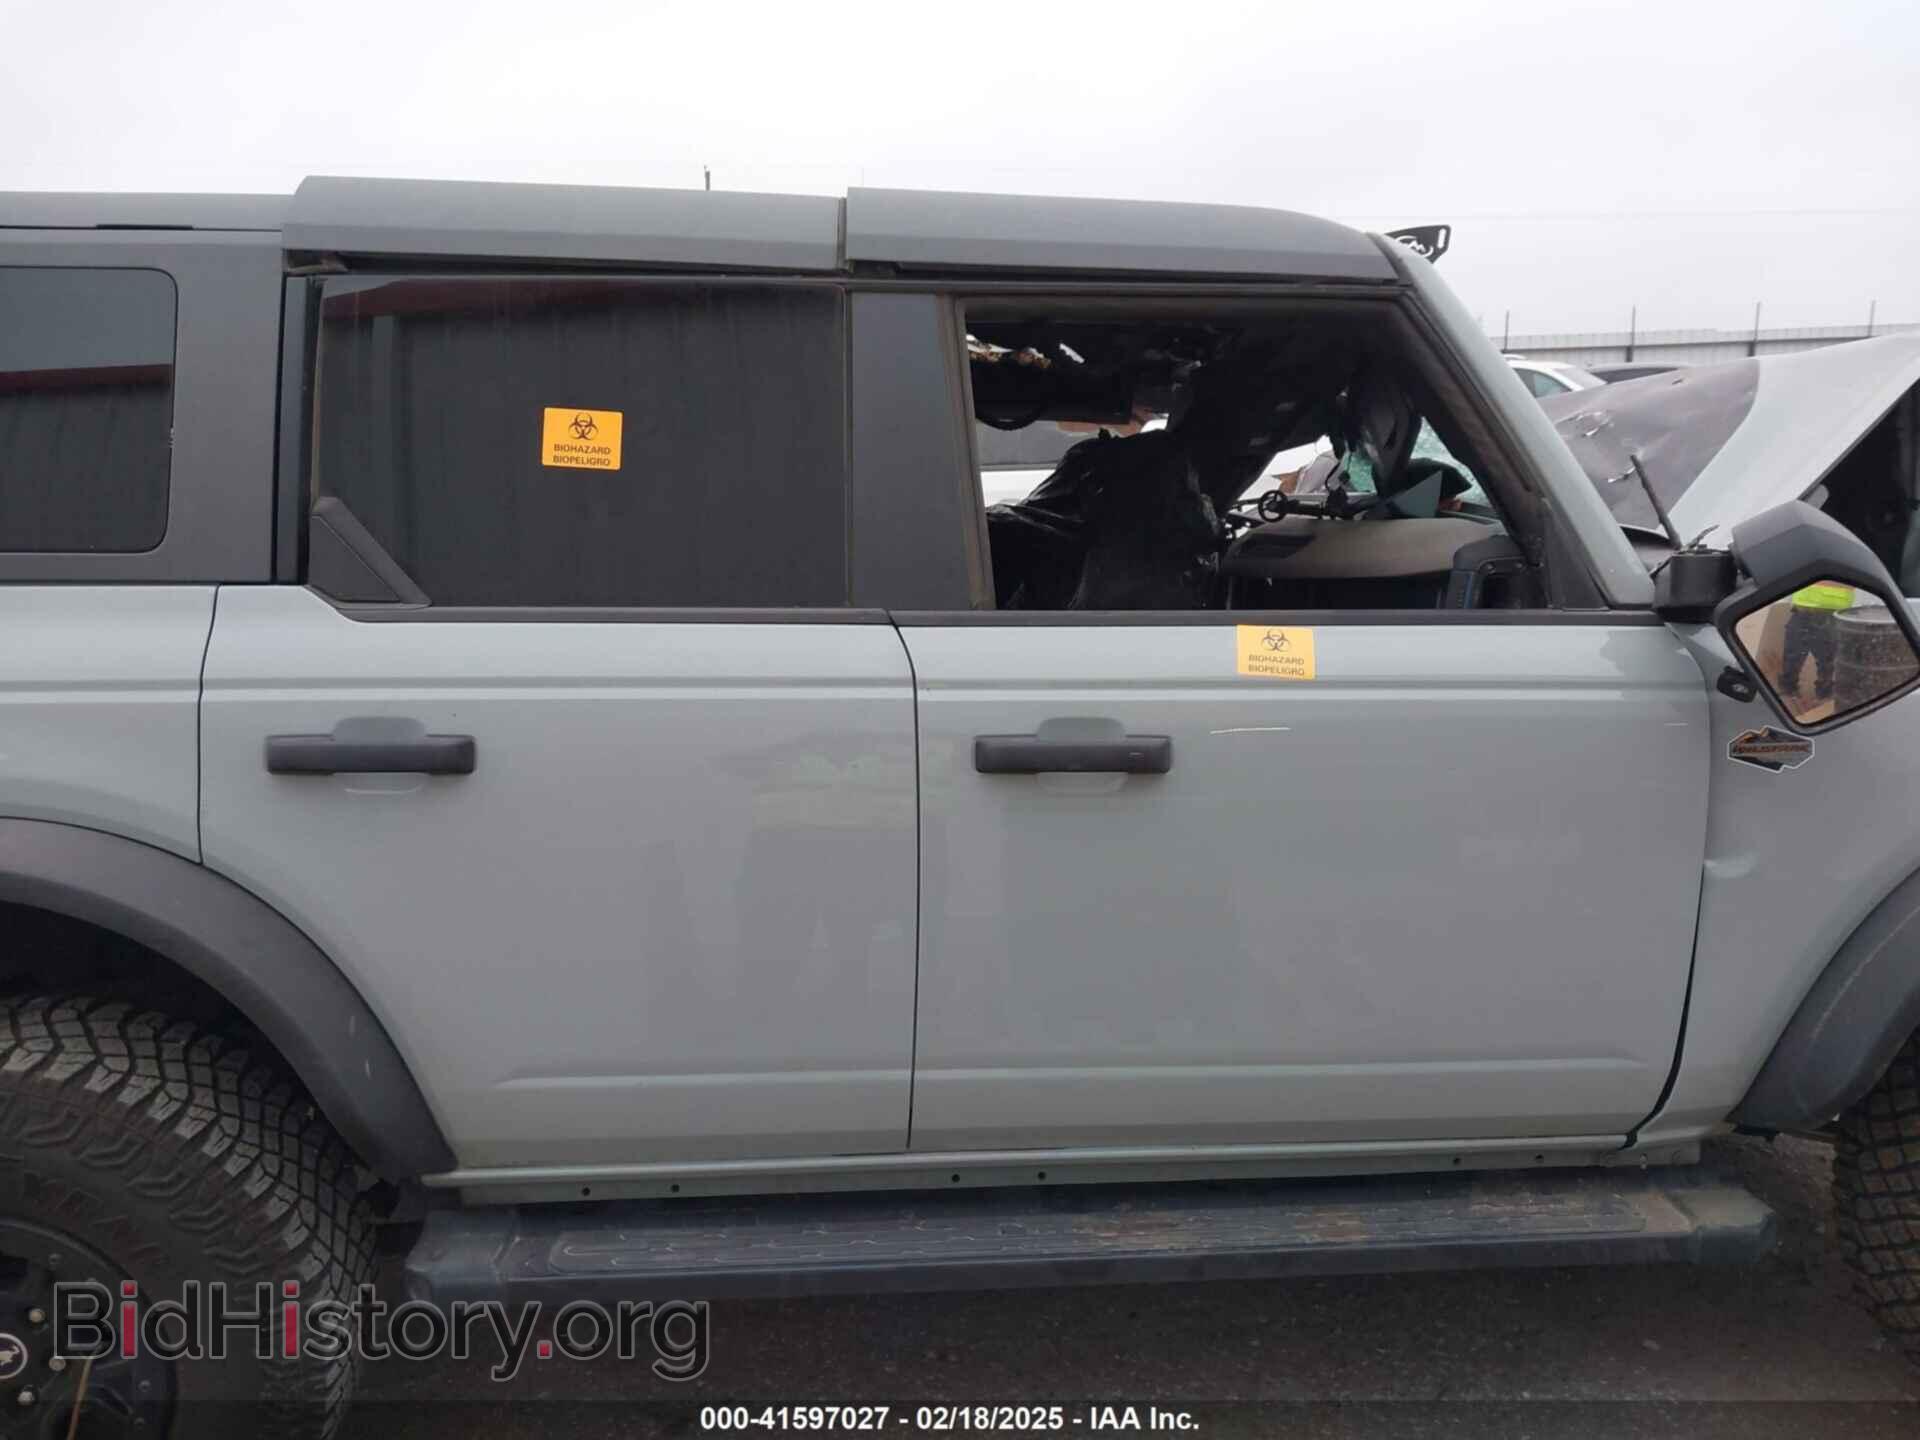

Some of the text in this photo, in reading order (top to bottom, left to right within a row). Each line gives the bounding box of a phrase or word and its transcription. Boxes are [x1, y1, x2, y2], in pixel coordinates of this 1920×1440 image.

[553, 443, 611, 455] BIOHAZARD
[553, 455, 611, 467] BIOPELIGRO
[1248, 654, 1305, 666] BIOHAZARD
[1248, 664, 1305, 677] BIOPELIGRO
